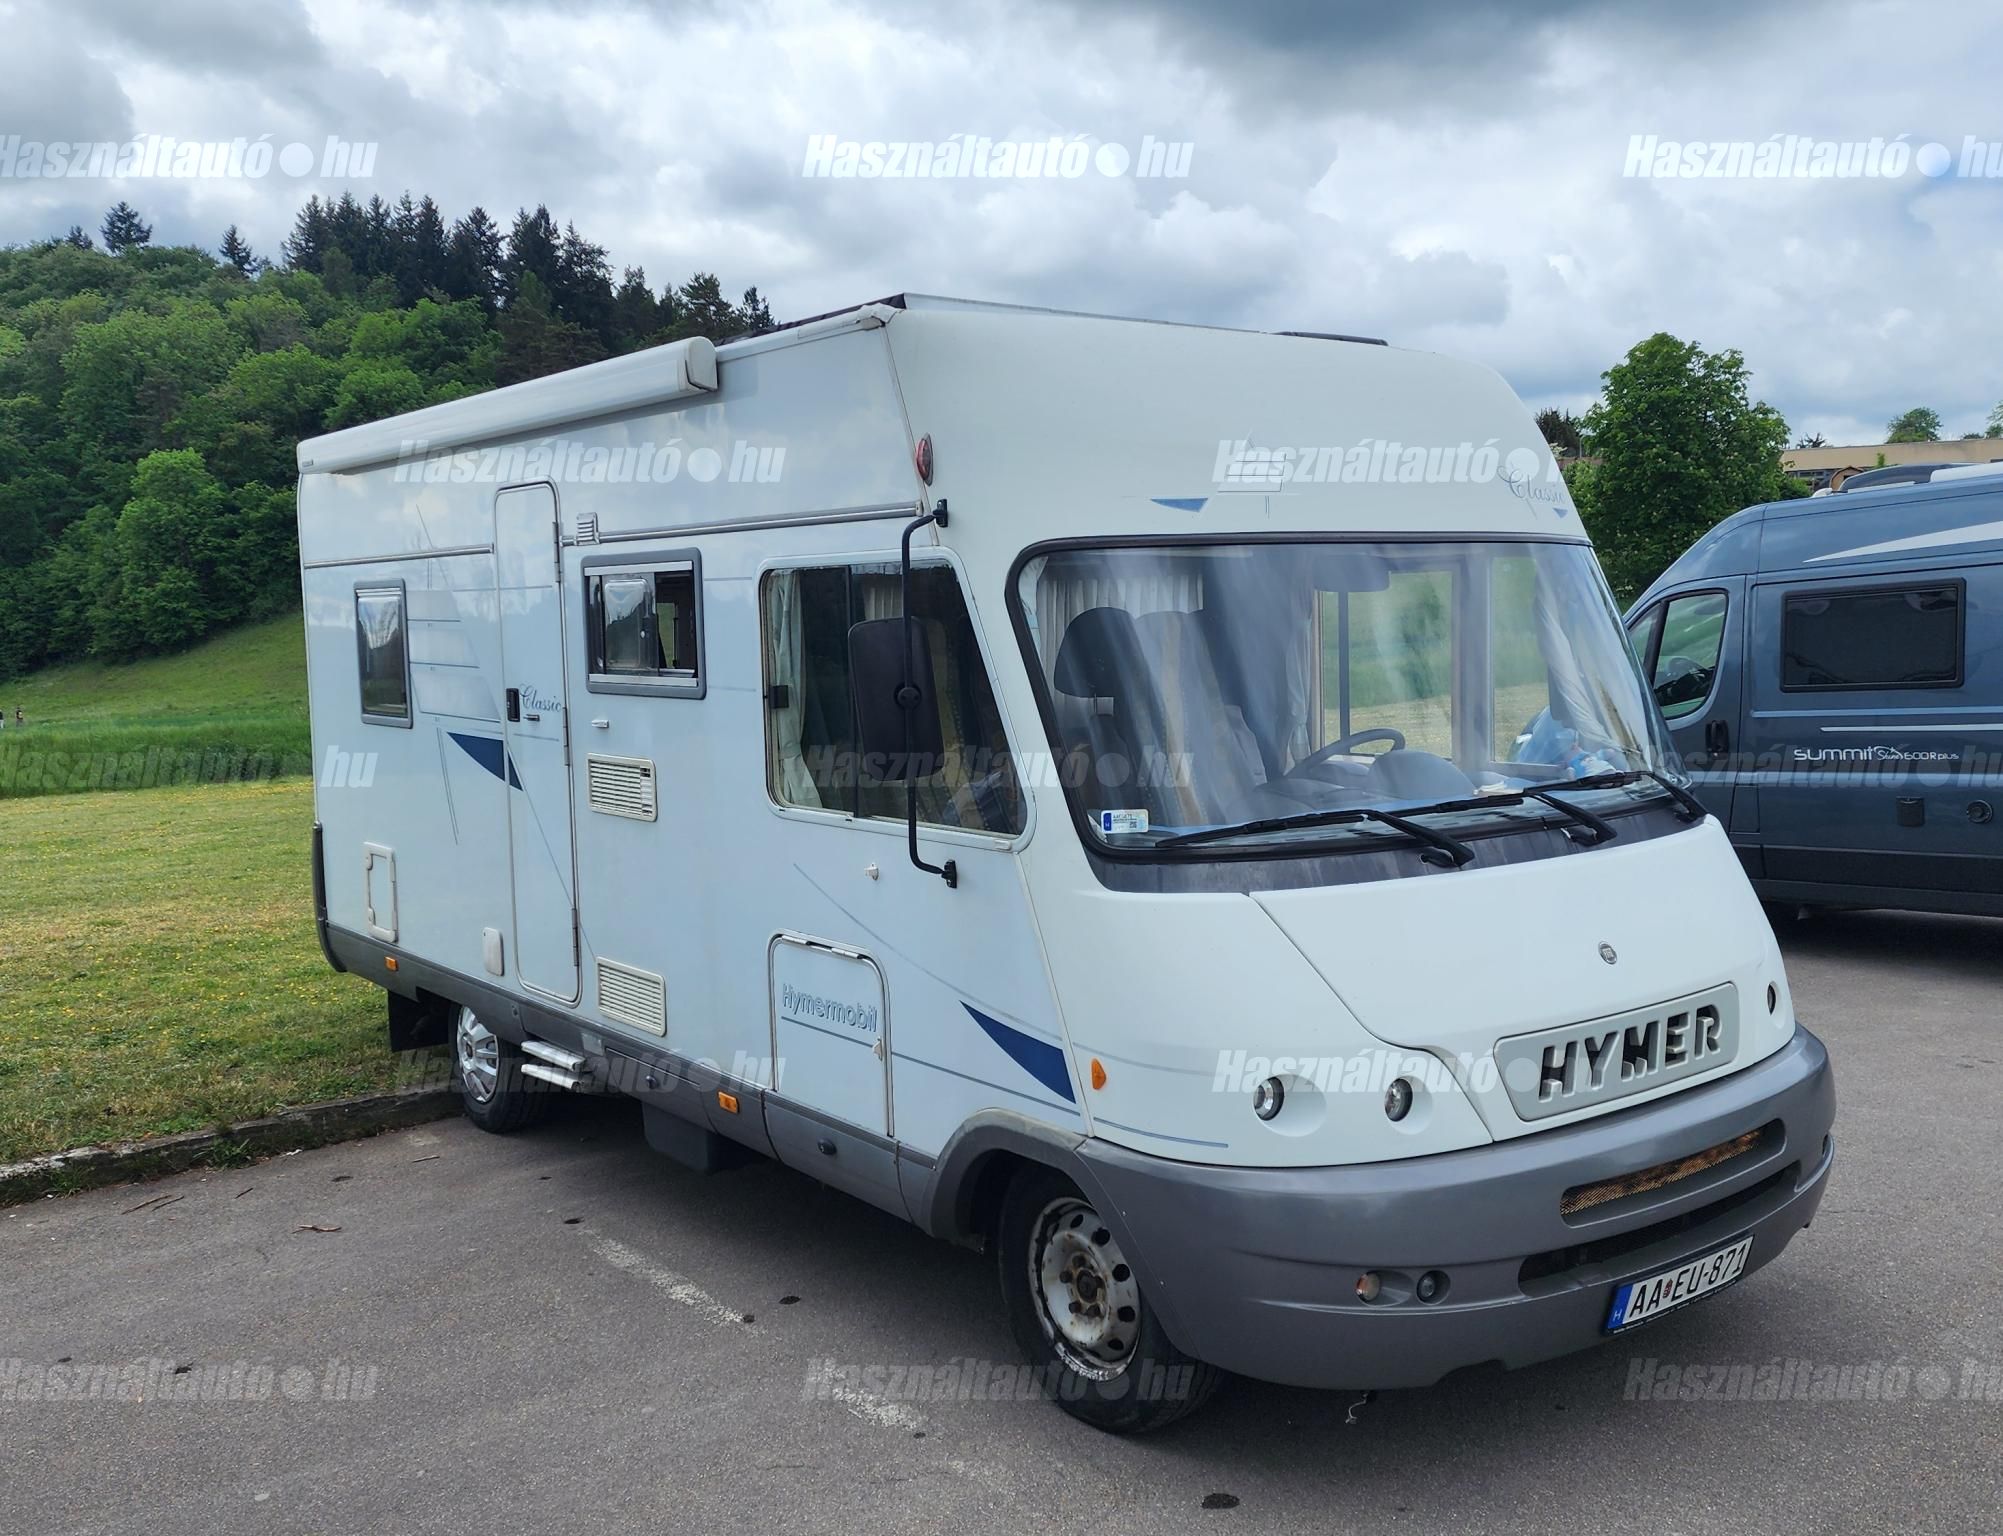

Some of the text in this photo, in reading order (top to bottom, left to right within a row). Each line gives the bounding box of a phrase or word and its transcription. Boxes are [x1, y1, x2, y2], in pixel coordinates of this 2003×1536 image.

[520, 683, 561, 712] Classic
[783, 984, 878, 1033] Hymermobil
[1538, 1004, 1722, 1103] HYMER
